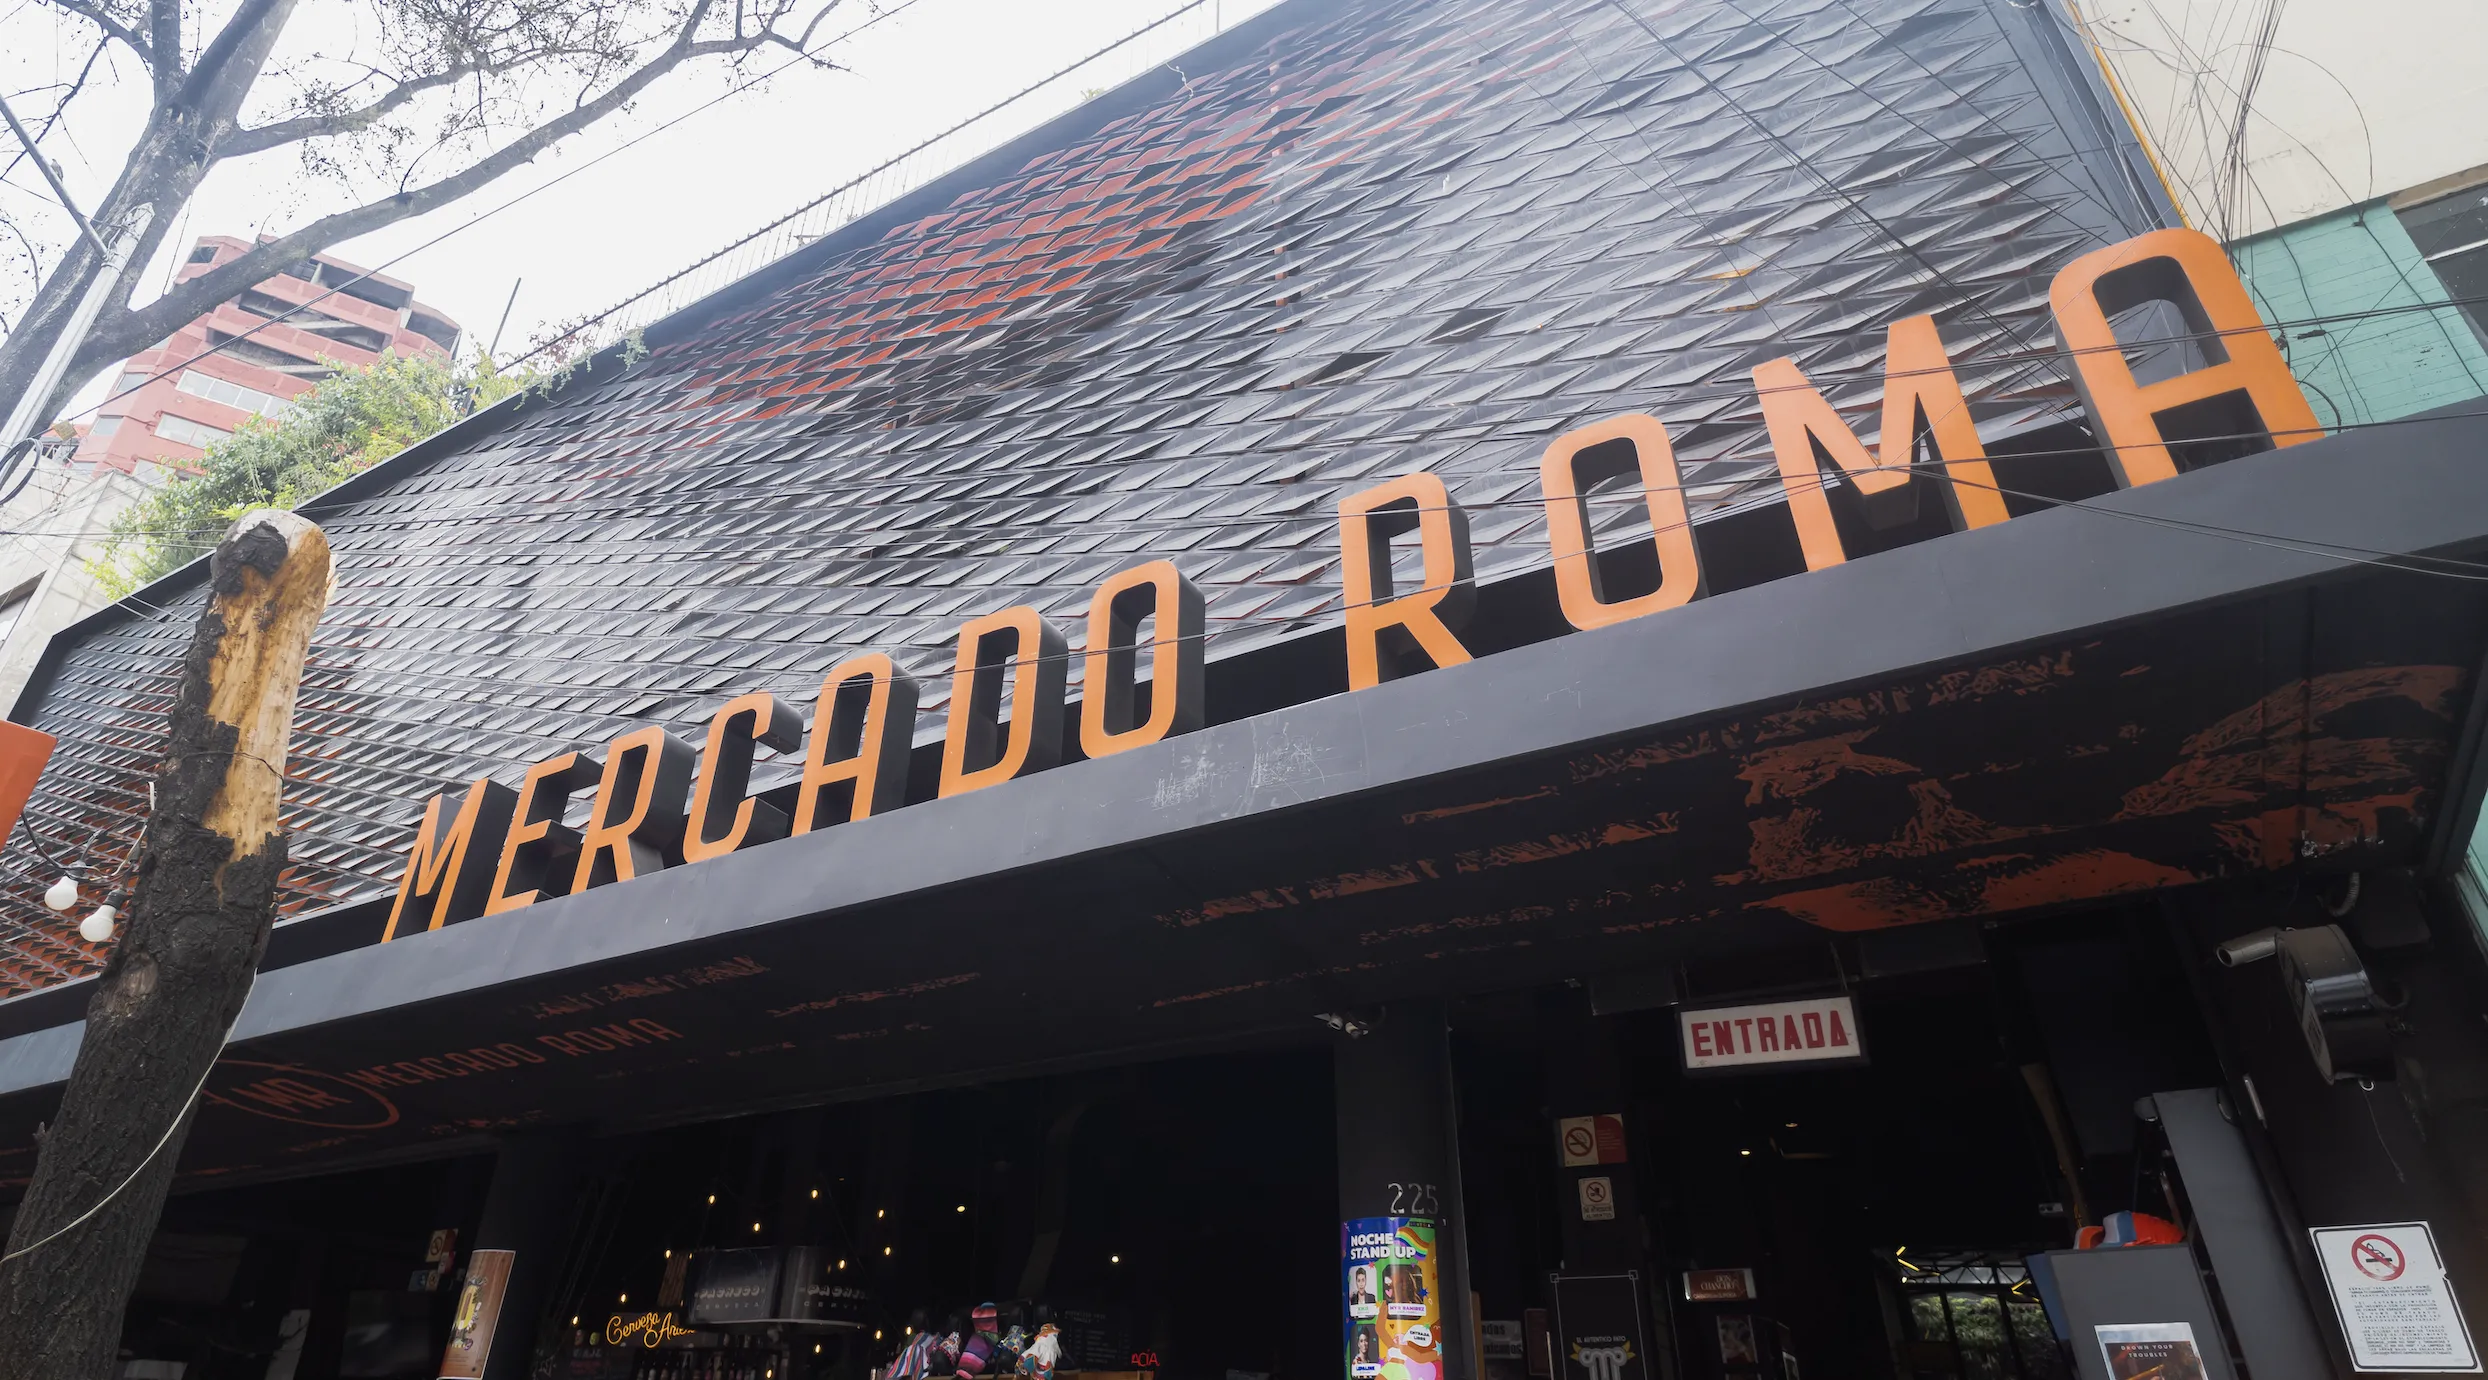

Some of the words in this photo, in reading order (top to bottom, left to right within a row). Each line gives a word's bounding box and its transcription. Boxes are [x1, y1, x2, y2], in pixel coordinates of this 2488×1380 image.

[382, 559, 1204, 943] MERCADO
[1338, 227, 2327, 692] ROMA
[1690, 1010, 1849, 1057] ENTRADA
[344, 1043, 551, 1090] MERCADO
[535, 1018, 686, 1057] ROMA
[1387, 1182, 1439, 1215] 225
[1350, 1232, 1395, 1247] NOCHE
[1350, 1246, 1391, 1260] STAND
[1394, 1246, 1417, 1259] UP
[606, 1312, 661, 1345] Cerveza
